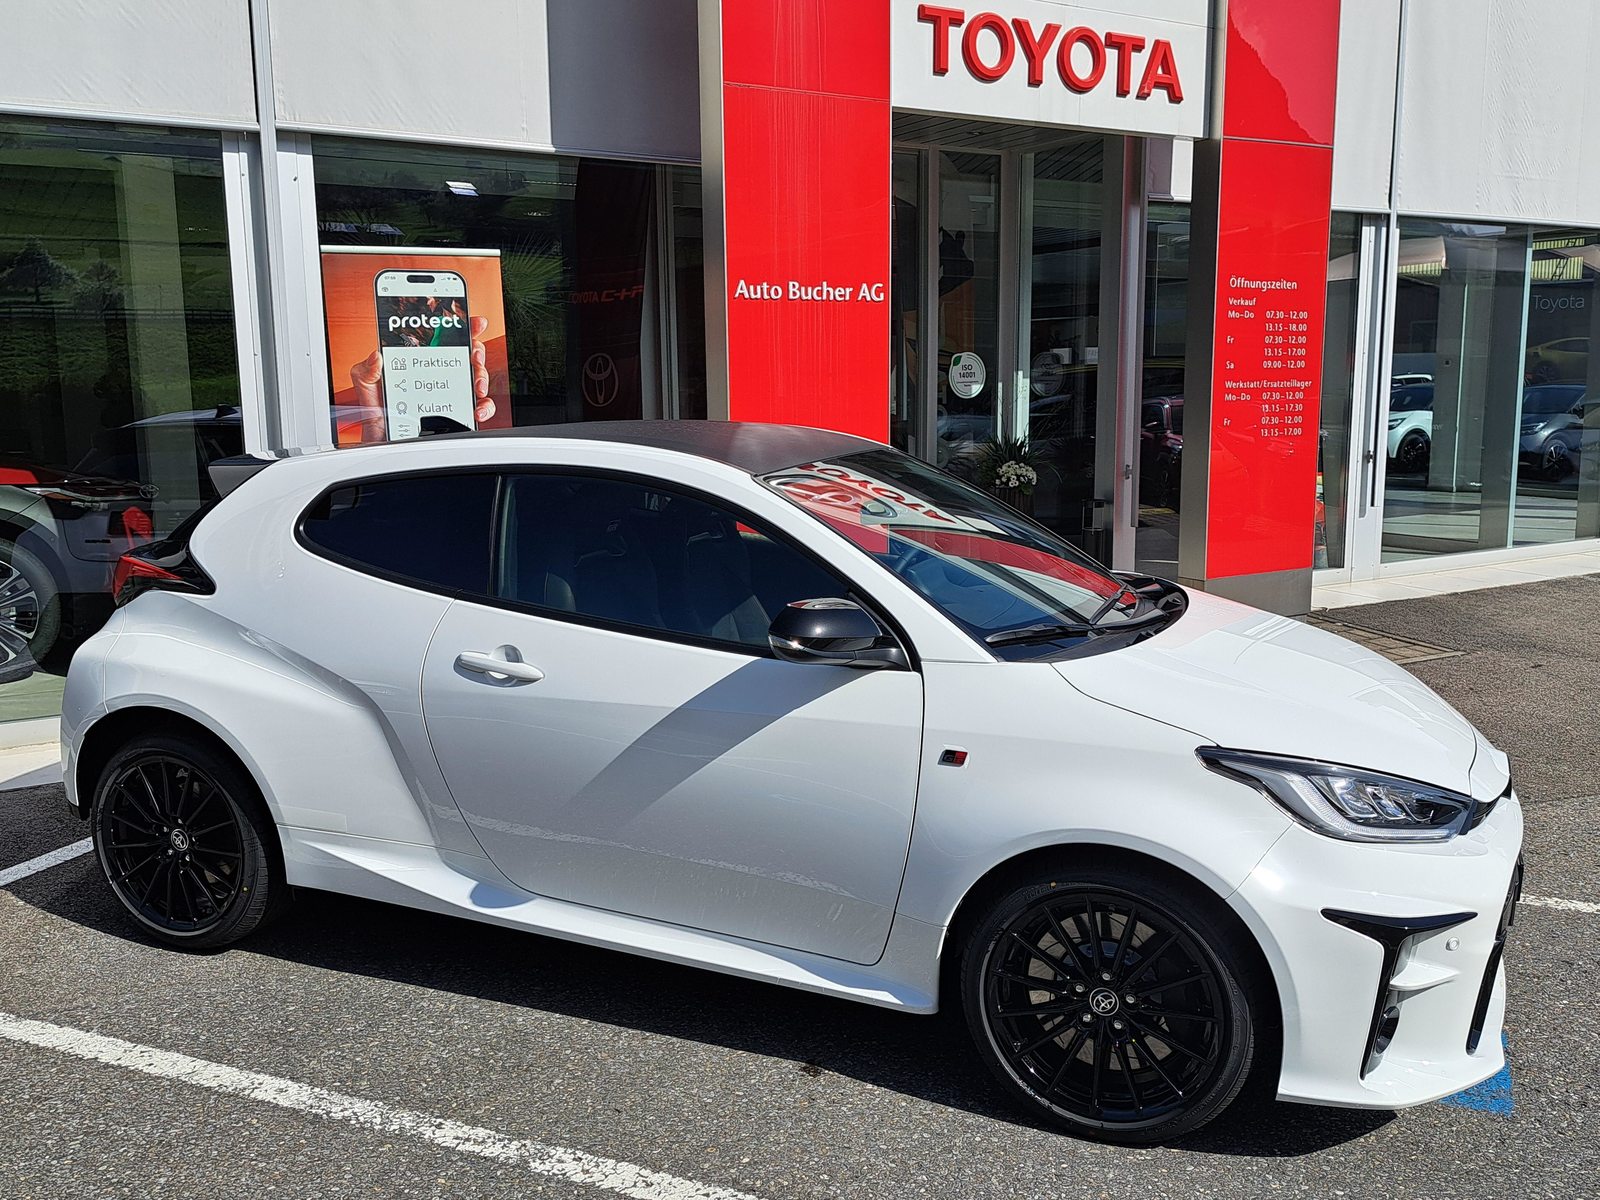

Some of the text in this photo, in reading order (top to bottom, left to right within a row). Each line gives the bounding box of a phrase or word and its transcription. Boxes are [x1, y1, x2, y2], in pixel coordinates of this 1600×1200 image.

[917, 4, 1184, 103] TOYOTA
[1229, 275, 1298, 292] Öffnungszeiten
[734, 279, 885, 303] Auto Bucher AG
[1228, 297, 1257, 306] Verkauf
[1532, 295, 1585, 313] Toyota
[388, 313, 463, 332] protect
[1226, 335, 1235, 344] Fr
[412, 357, 462, 368] Praktisch
[1225, 360, 1235, 369] Sa
[958, 371, 976, 379] 14001
[414, 379, 450, 392] Digital
[1224, 379, 1313, 390] Werkstatt/Ersatzteillager
[417, 402, 453, 413] Kulant
[1223, 417, 1231, 426] Fr
